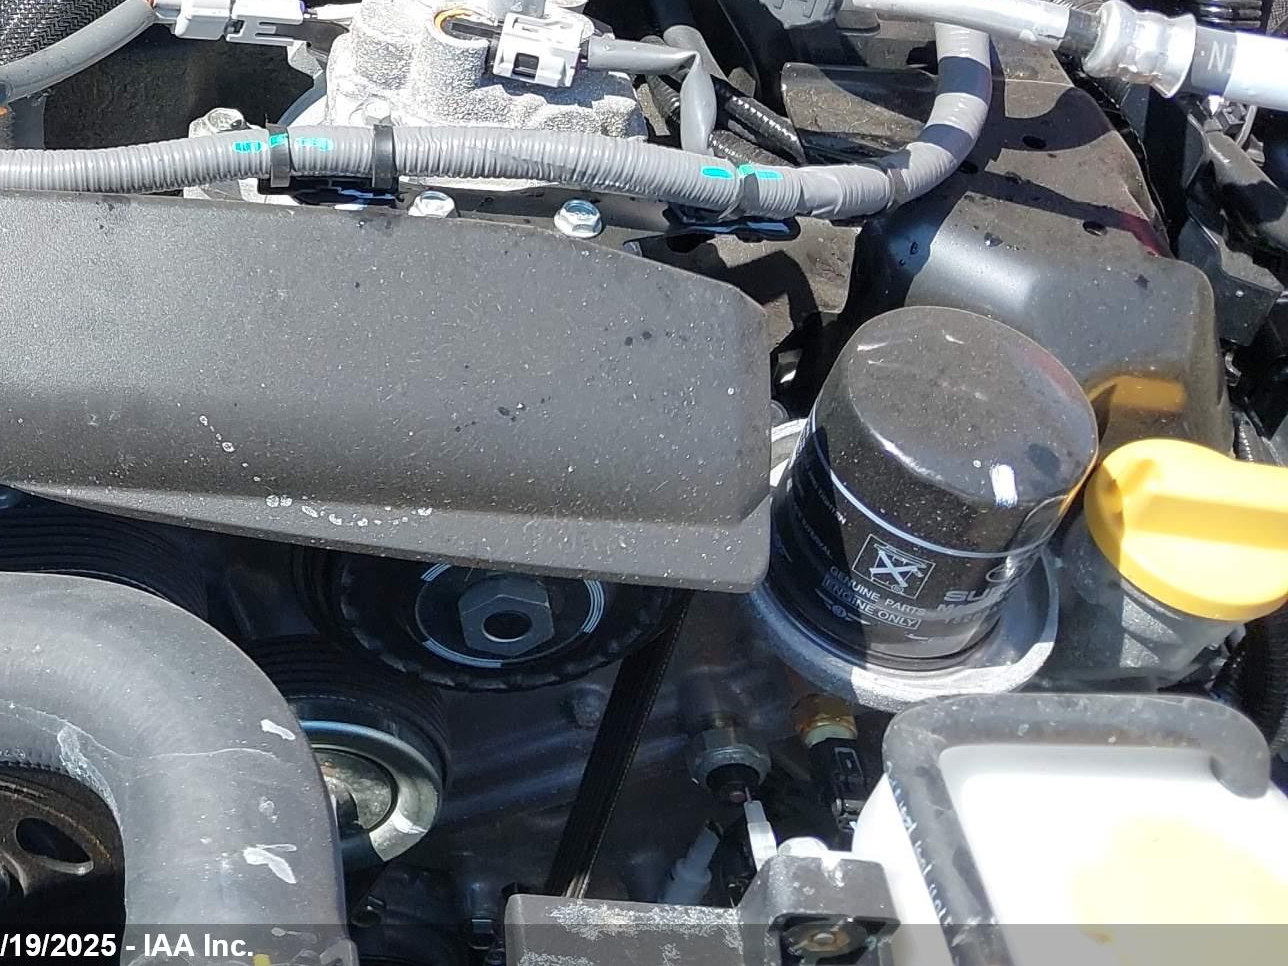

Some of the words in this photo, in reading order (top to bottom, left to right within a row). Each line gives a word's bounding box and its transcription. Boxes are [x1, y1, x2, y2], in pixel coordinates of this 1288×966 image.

[823, 576, 875, 614] ENGINE
[878, 610, 918, 627] ONLY
[830, 566, 880, 602] GENUINE
[884, 598, 926, 616] PARTS
